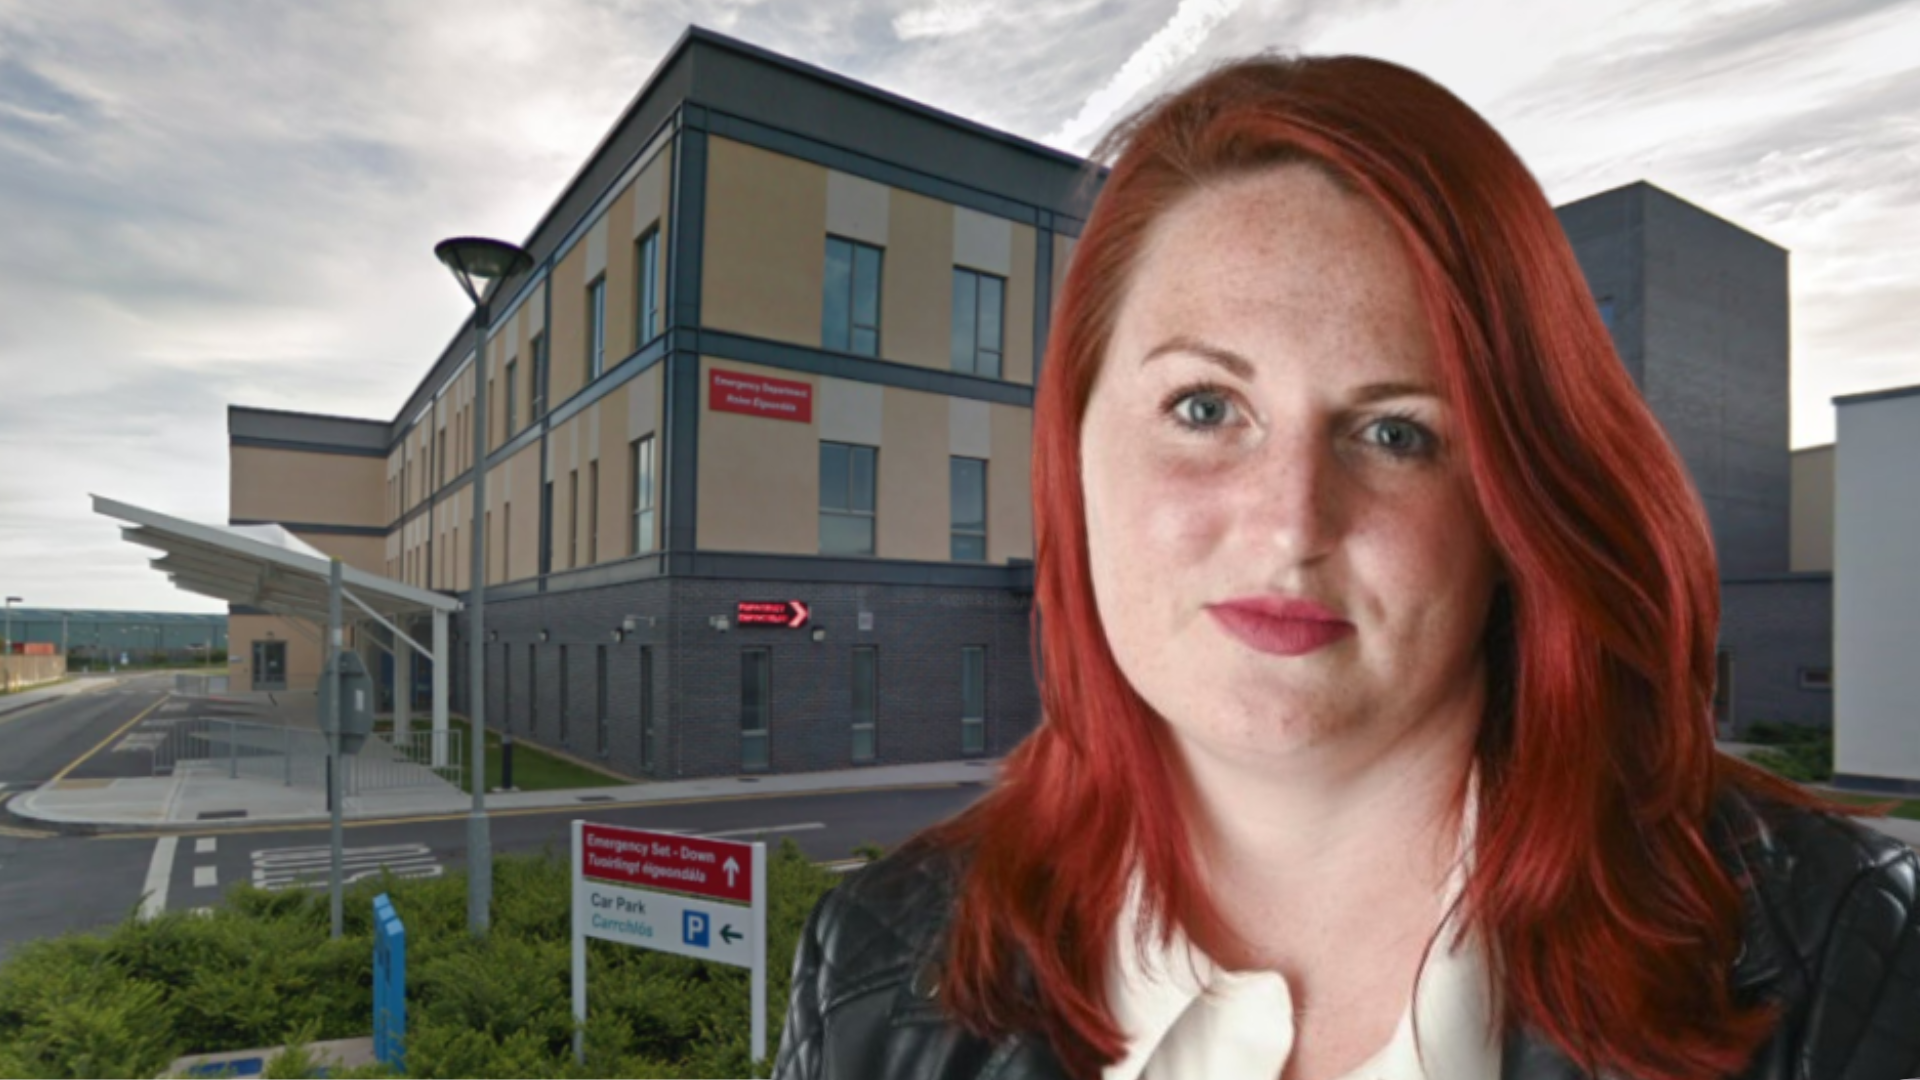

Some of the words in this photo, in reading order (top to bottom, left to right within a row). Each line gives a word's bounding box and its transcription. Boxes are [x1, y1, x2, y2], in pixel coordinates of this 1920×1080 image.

[587, 833, 648, 857] Emergency
[651, 842, 671, 857] Set
[681, 846, 716, 863] Down
[591, 893, 613, 908] Car
[616, 897, 646, 914] Park
[688, 915, 703, 941] P
